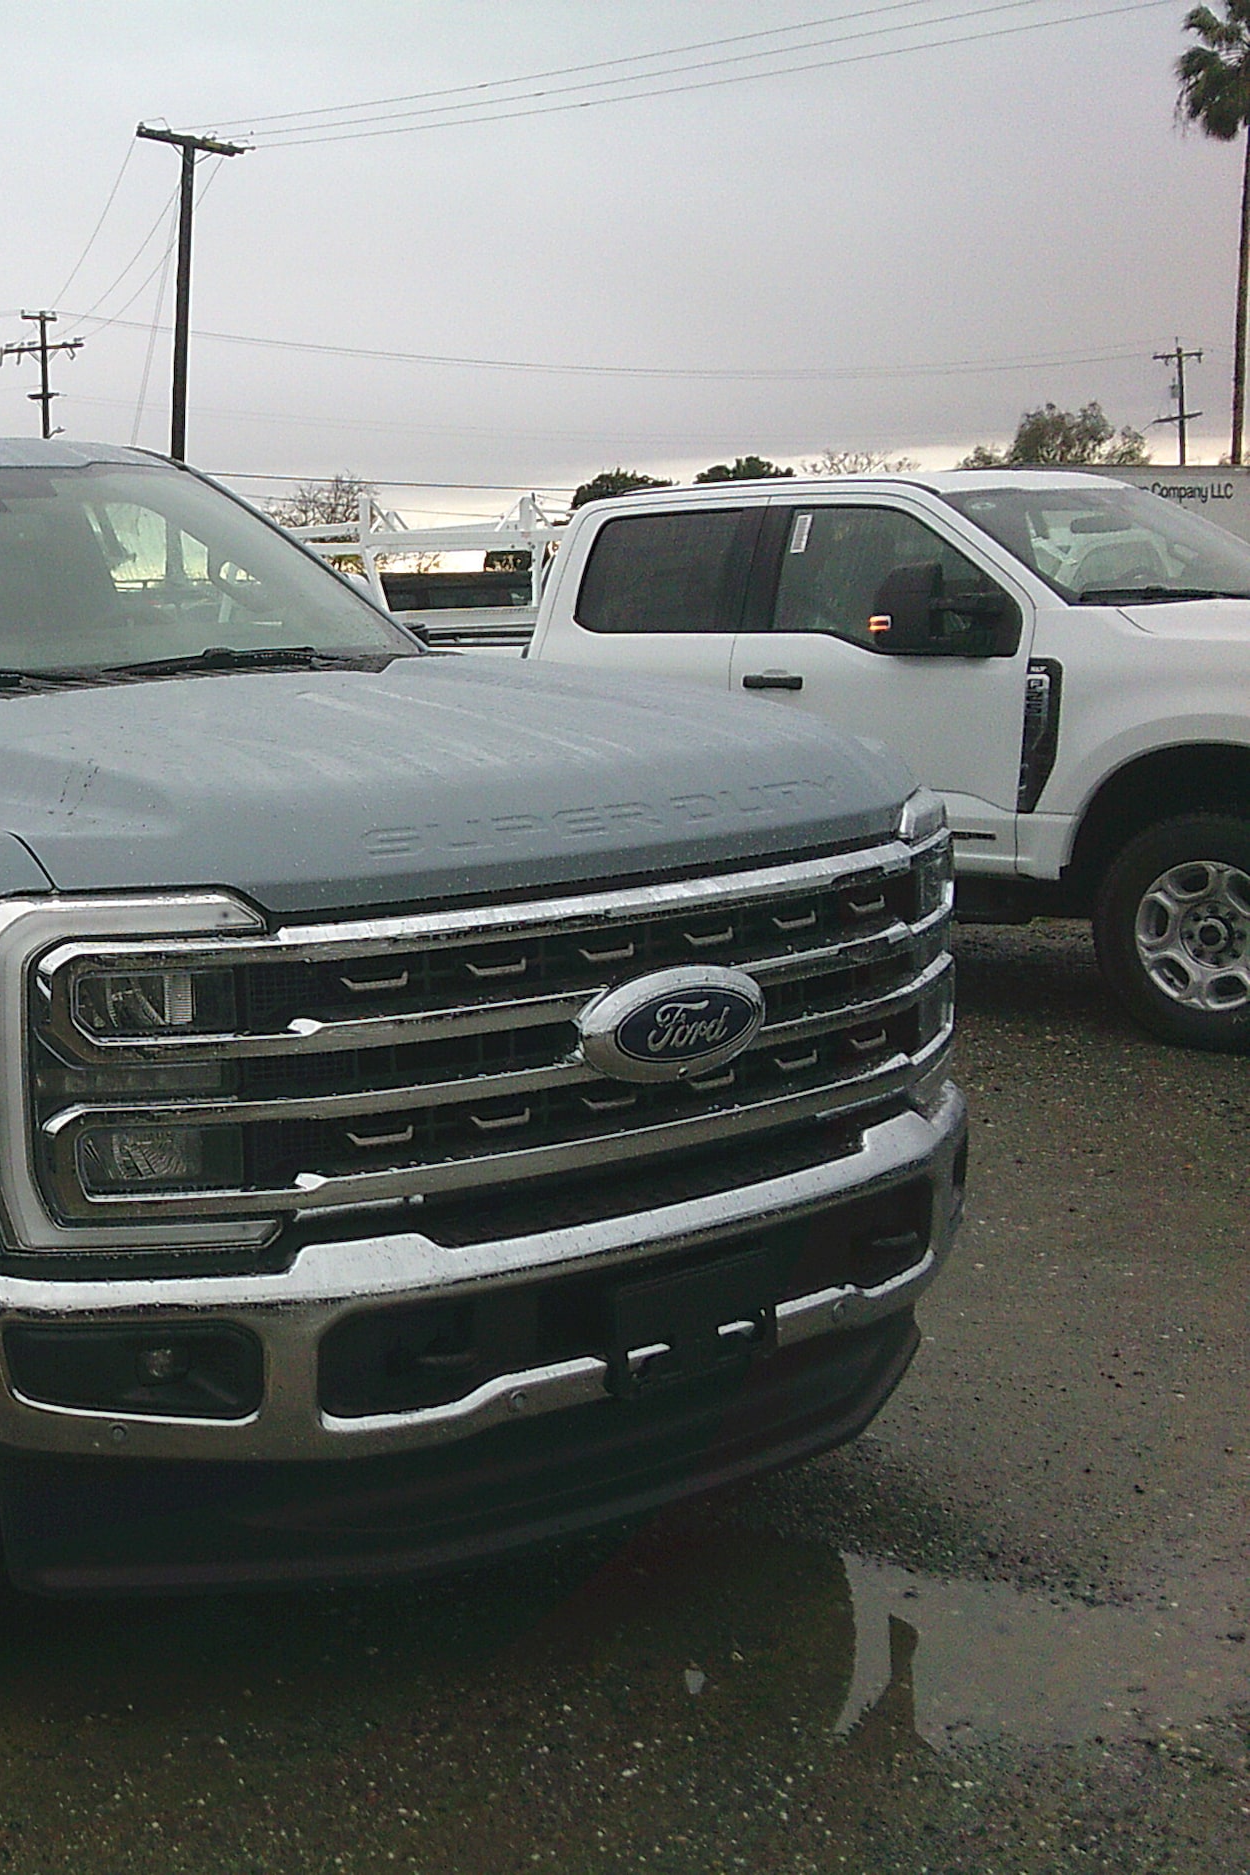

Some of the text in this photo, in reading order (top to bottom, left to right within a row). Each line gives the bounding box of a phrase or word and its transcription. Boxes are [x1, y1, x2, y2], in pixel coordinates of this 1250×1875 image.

[1151, 482, 1234, 504] Company LLC
[360, 775, 836, 860] SUPER DUTY
[647, 999, 731, 1053] Ford
